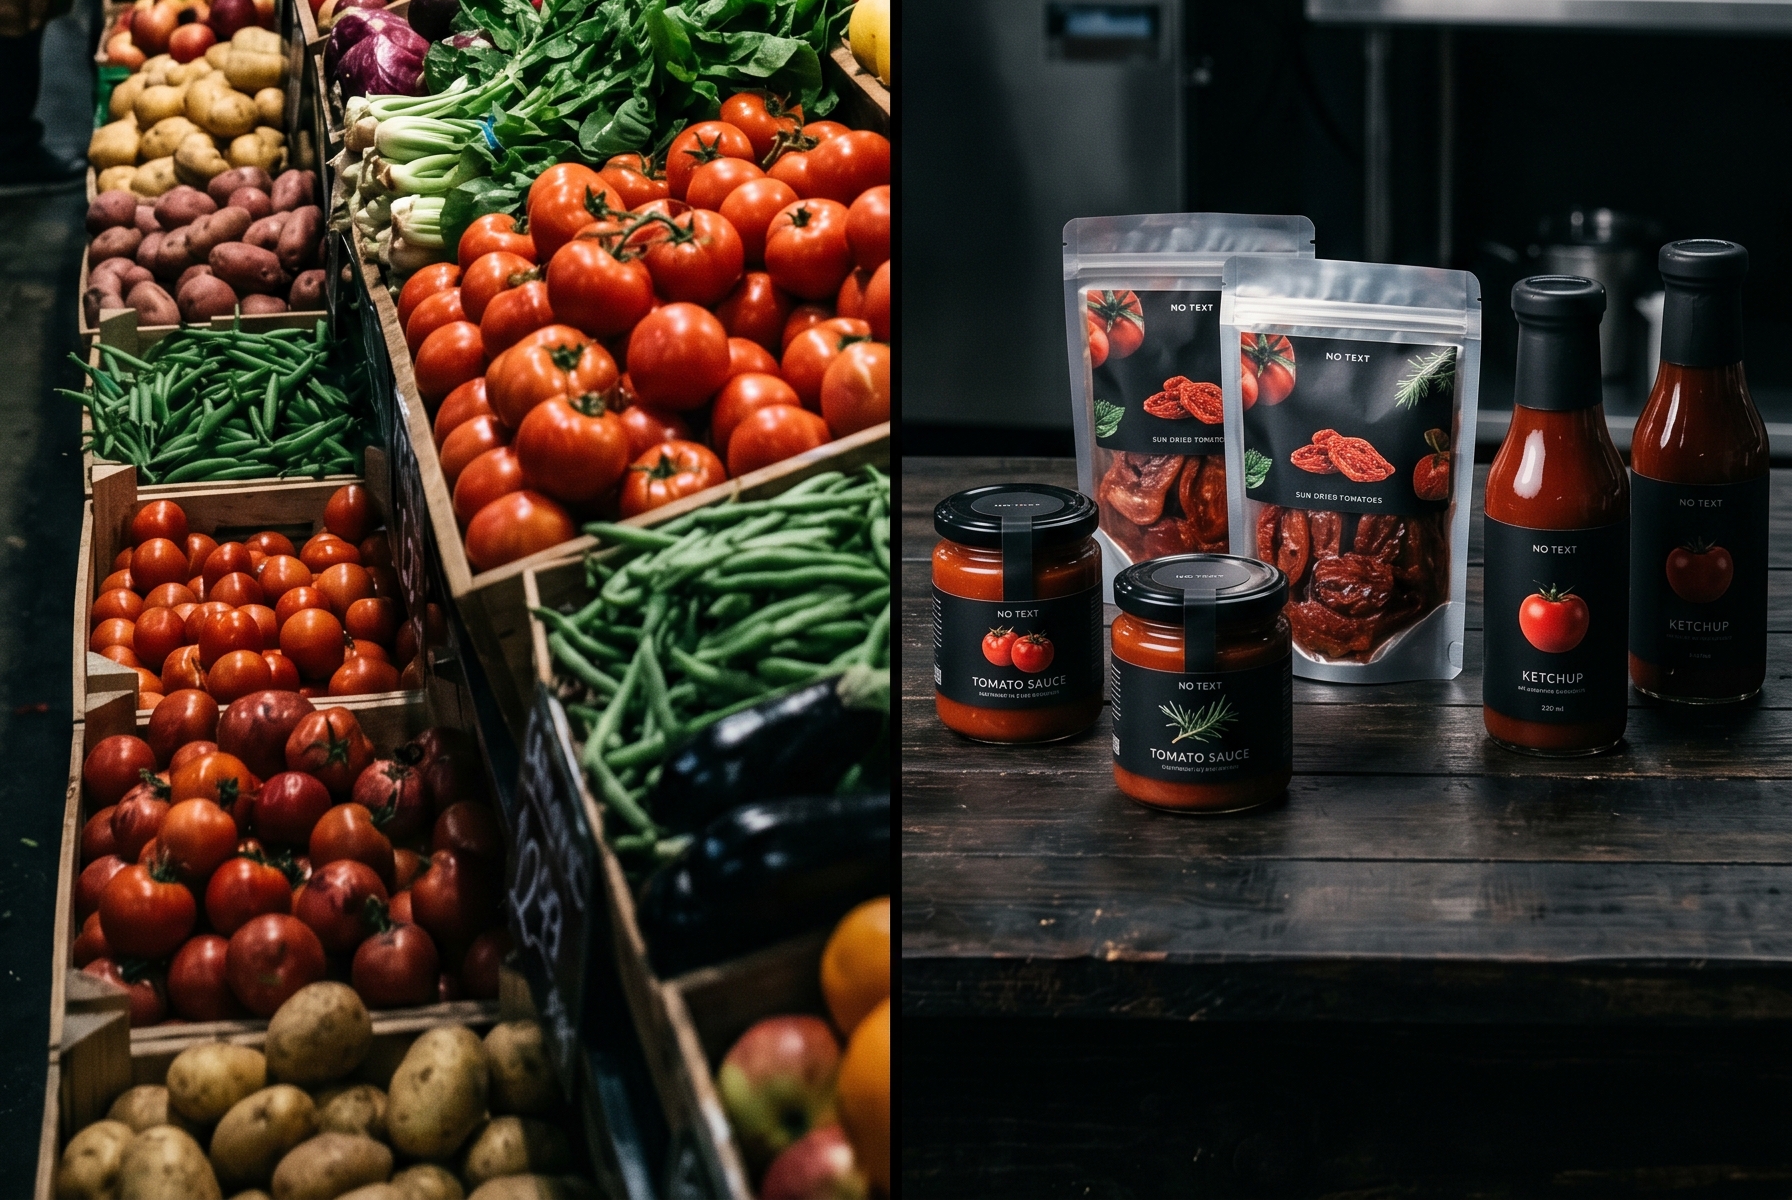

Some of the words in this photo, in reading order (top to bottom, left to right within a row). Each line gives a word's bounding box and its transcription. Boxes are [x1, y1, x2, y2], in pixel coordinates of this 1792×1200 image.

[1170, 303, 1187, 312] NO
[1189, 303, 1214, 312] TEXT
[1325, 352, 1342, 361] NO
[1345, 353, 1371, 363] TEXT
[1295, 491, 1312, 499] SUN
[1679, 498, 1695, 507] NO
[1697, 499, 1723, 508] TEXT
[1532, 544, 1549, 554] NO
[1551, 545, 1578, 555] TEXT
[997, 610, 1013, 619] NO
[1015, 609, 1039, 618] TEXT
[1669, 619, 1730, 632] KETCHUP
[972, 676, 1024, 690] TOMATO
[1027, 674, 1067, 690] SAUCE
[1522, 670, 1584, 684] KETCHUP
[1178, 681, 1194, 691] NO
[1196, 681, 1223, 691] TEXT
[1150, 747, 1205, 763] TOMATO
[1208, 748, 1250, 763] SAUCE
